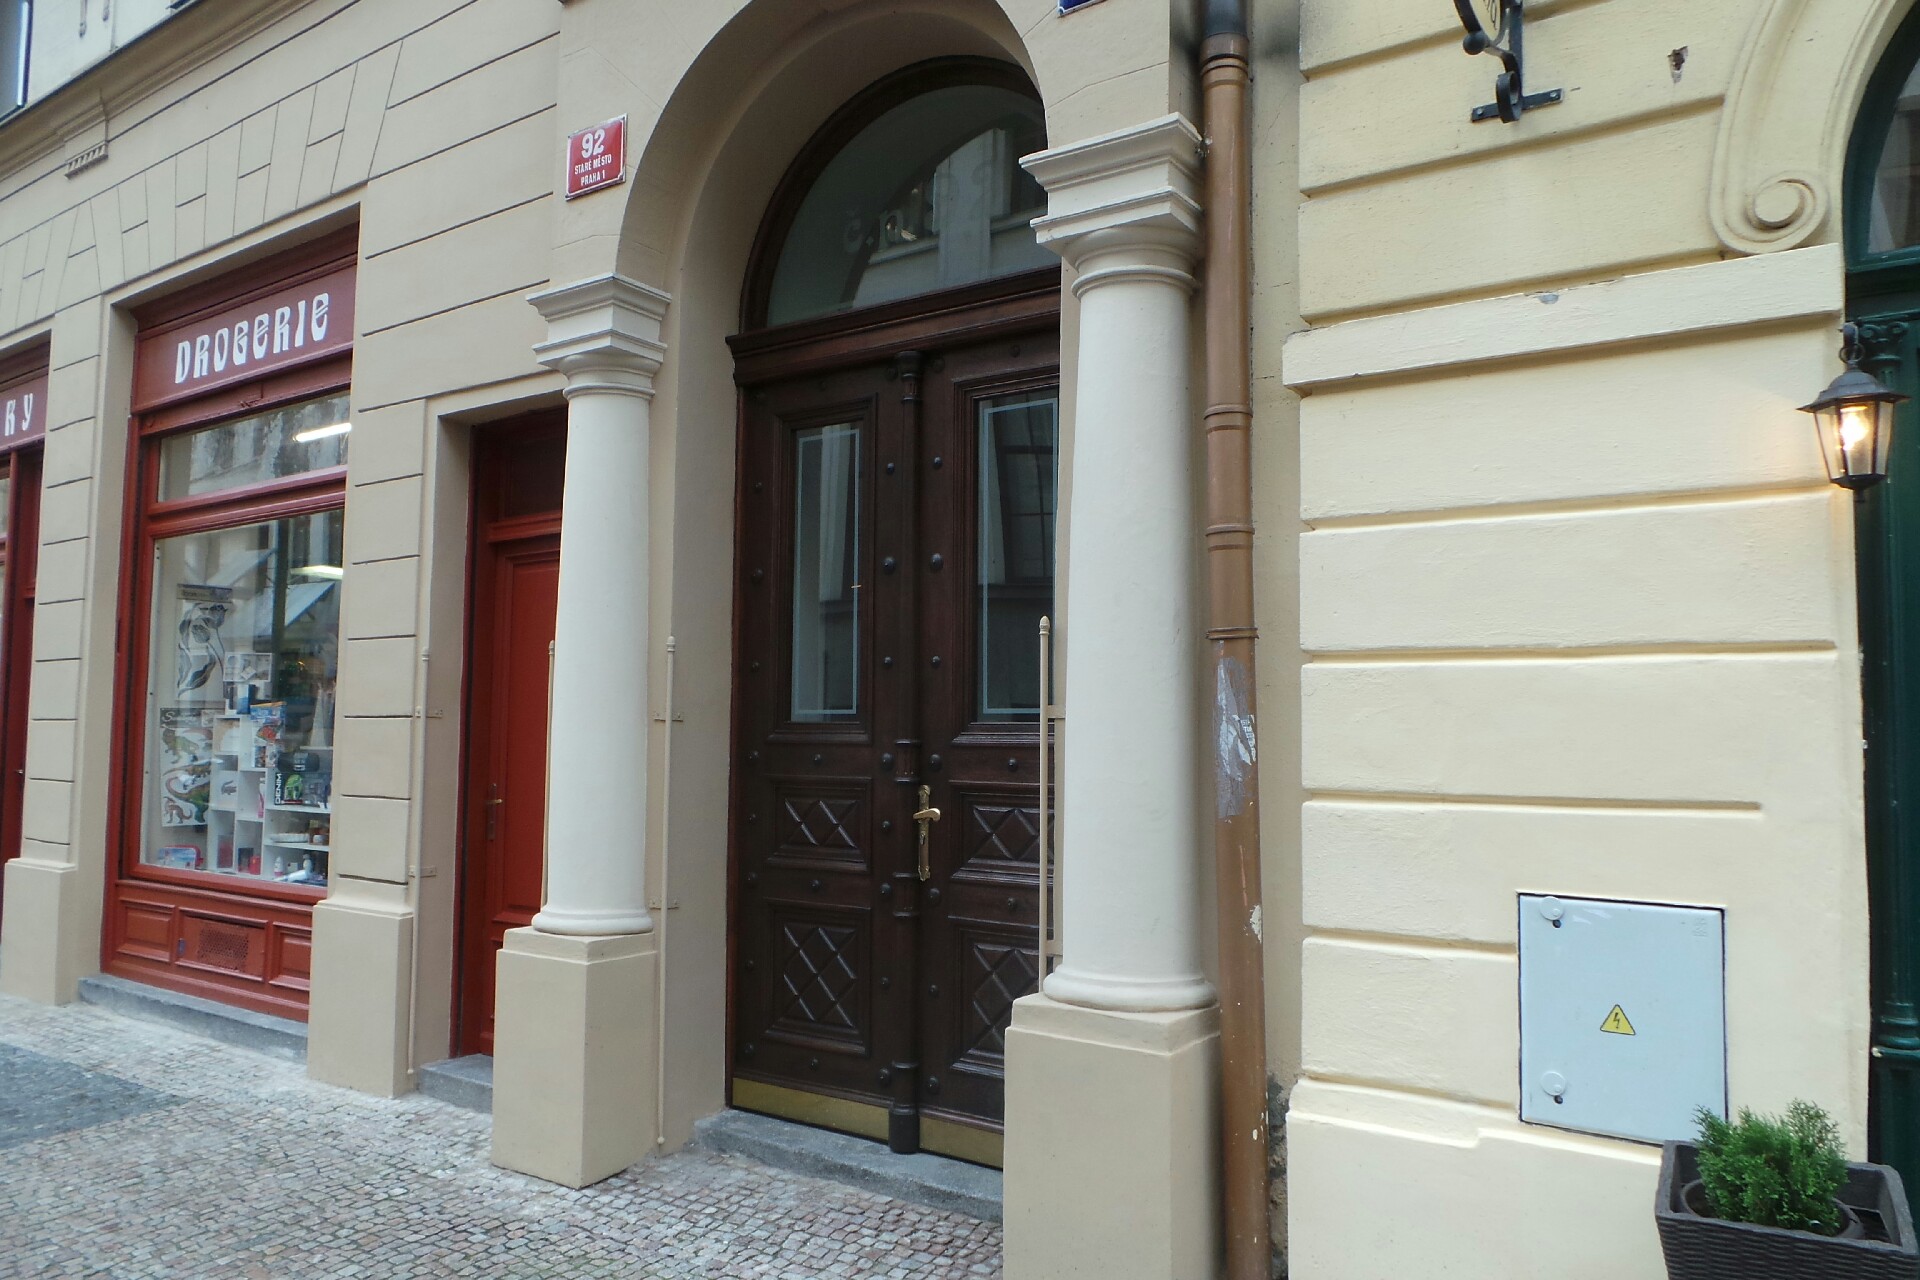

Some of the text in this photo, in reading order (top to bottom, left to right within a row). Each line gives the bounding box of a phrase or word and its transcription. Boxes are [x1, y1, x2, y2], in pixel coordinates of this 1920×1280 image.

[581, 128, 605, 159] 92
[574, 153, 612, 175] STARÉ MĚSTO
[580, 169, 606, 187] PRAHA 1
[174, 292, 329, 384] DROGERIE
